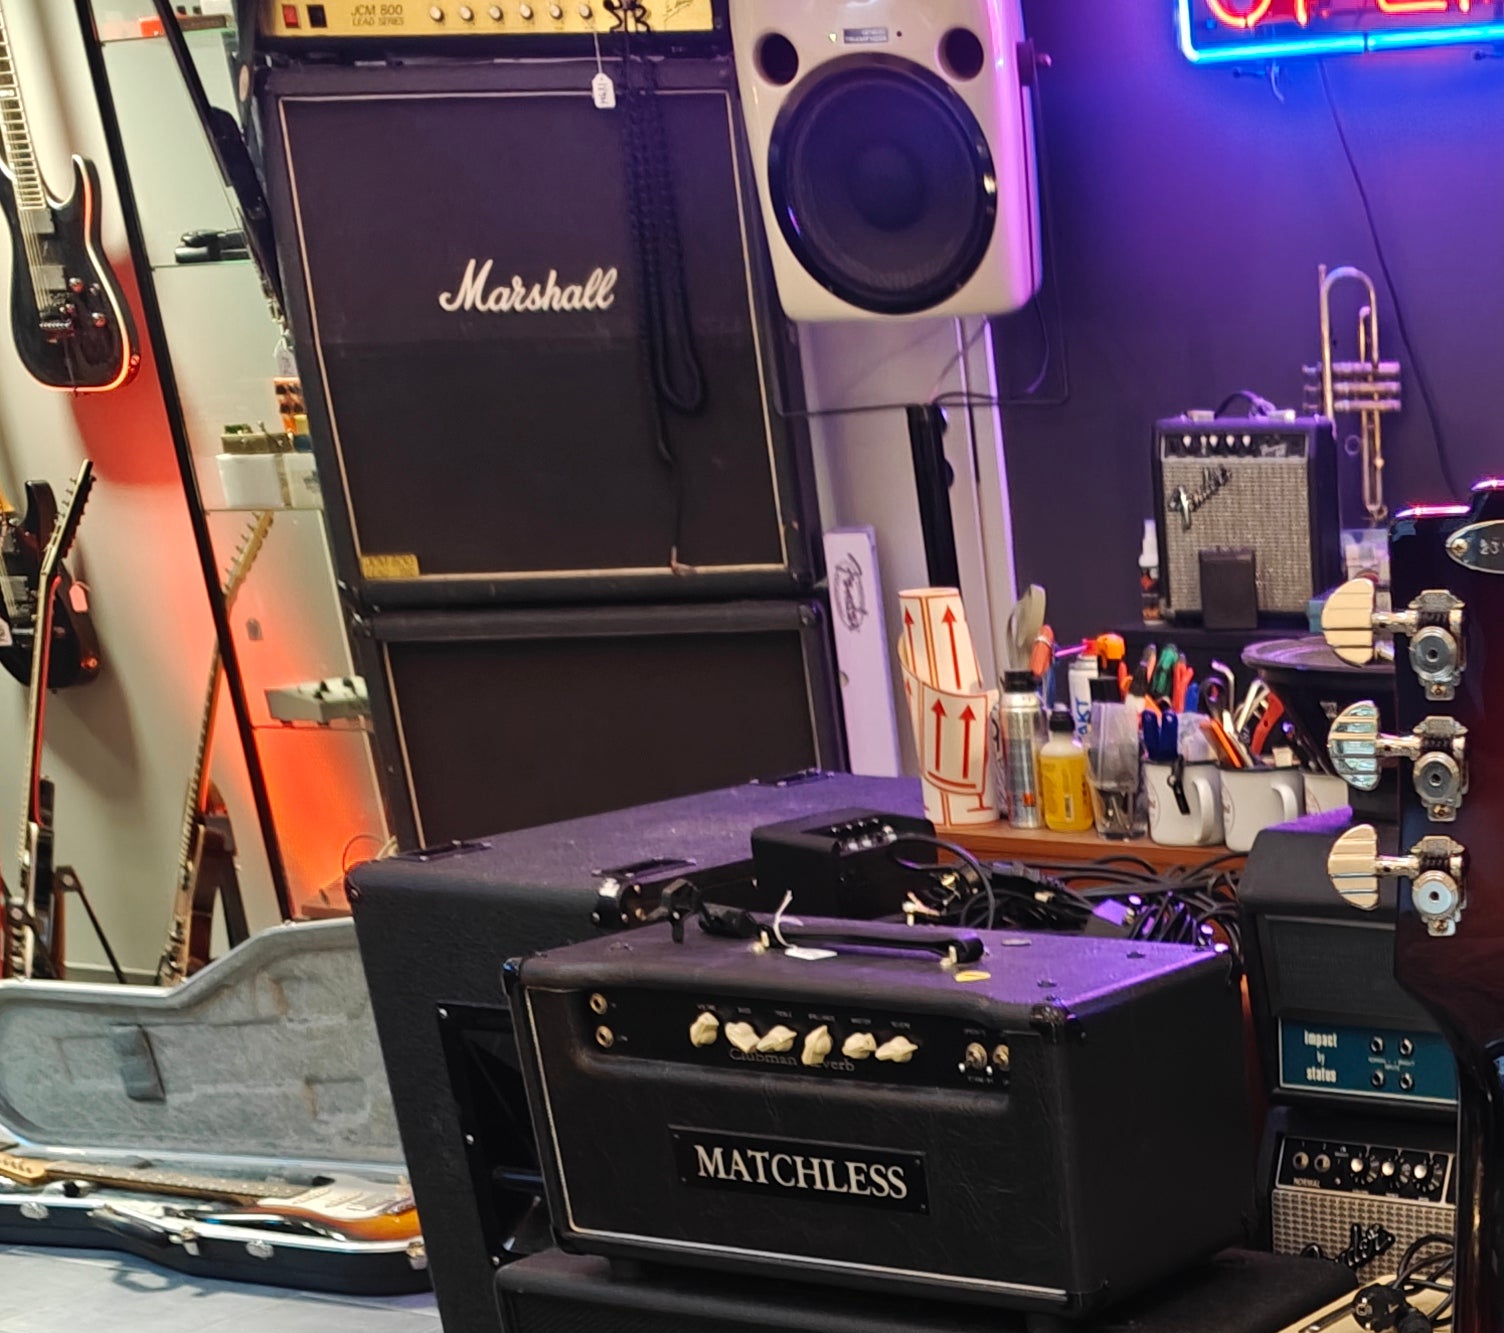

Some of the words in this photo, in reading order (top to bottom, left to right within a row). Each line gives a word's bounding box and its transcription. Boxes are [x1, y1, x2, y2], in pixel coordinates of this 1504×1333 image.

[351, 4, 375, 16] JCM
[380, 4, 403, 15] 800
[439, 258, 618, 312] Marshall
[1304, 1030, 1337, 1048] Impact
[730, 1048, 797, 1066] Clubman
[1316, 1051, 1325, 1066] by
[1306, 1066, 1336, 1083] status
[694, 1145, 907, 1199] MATCHLESS
